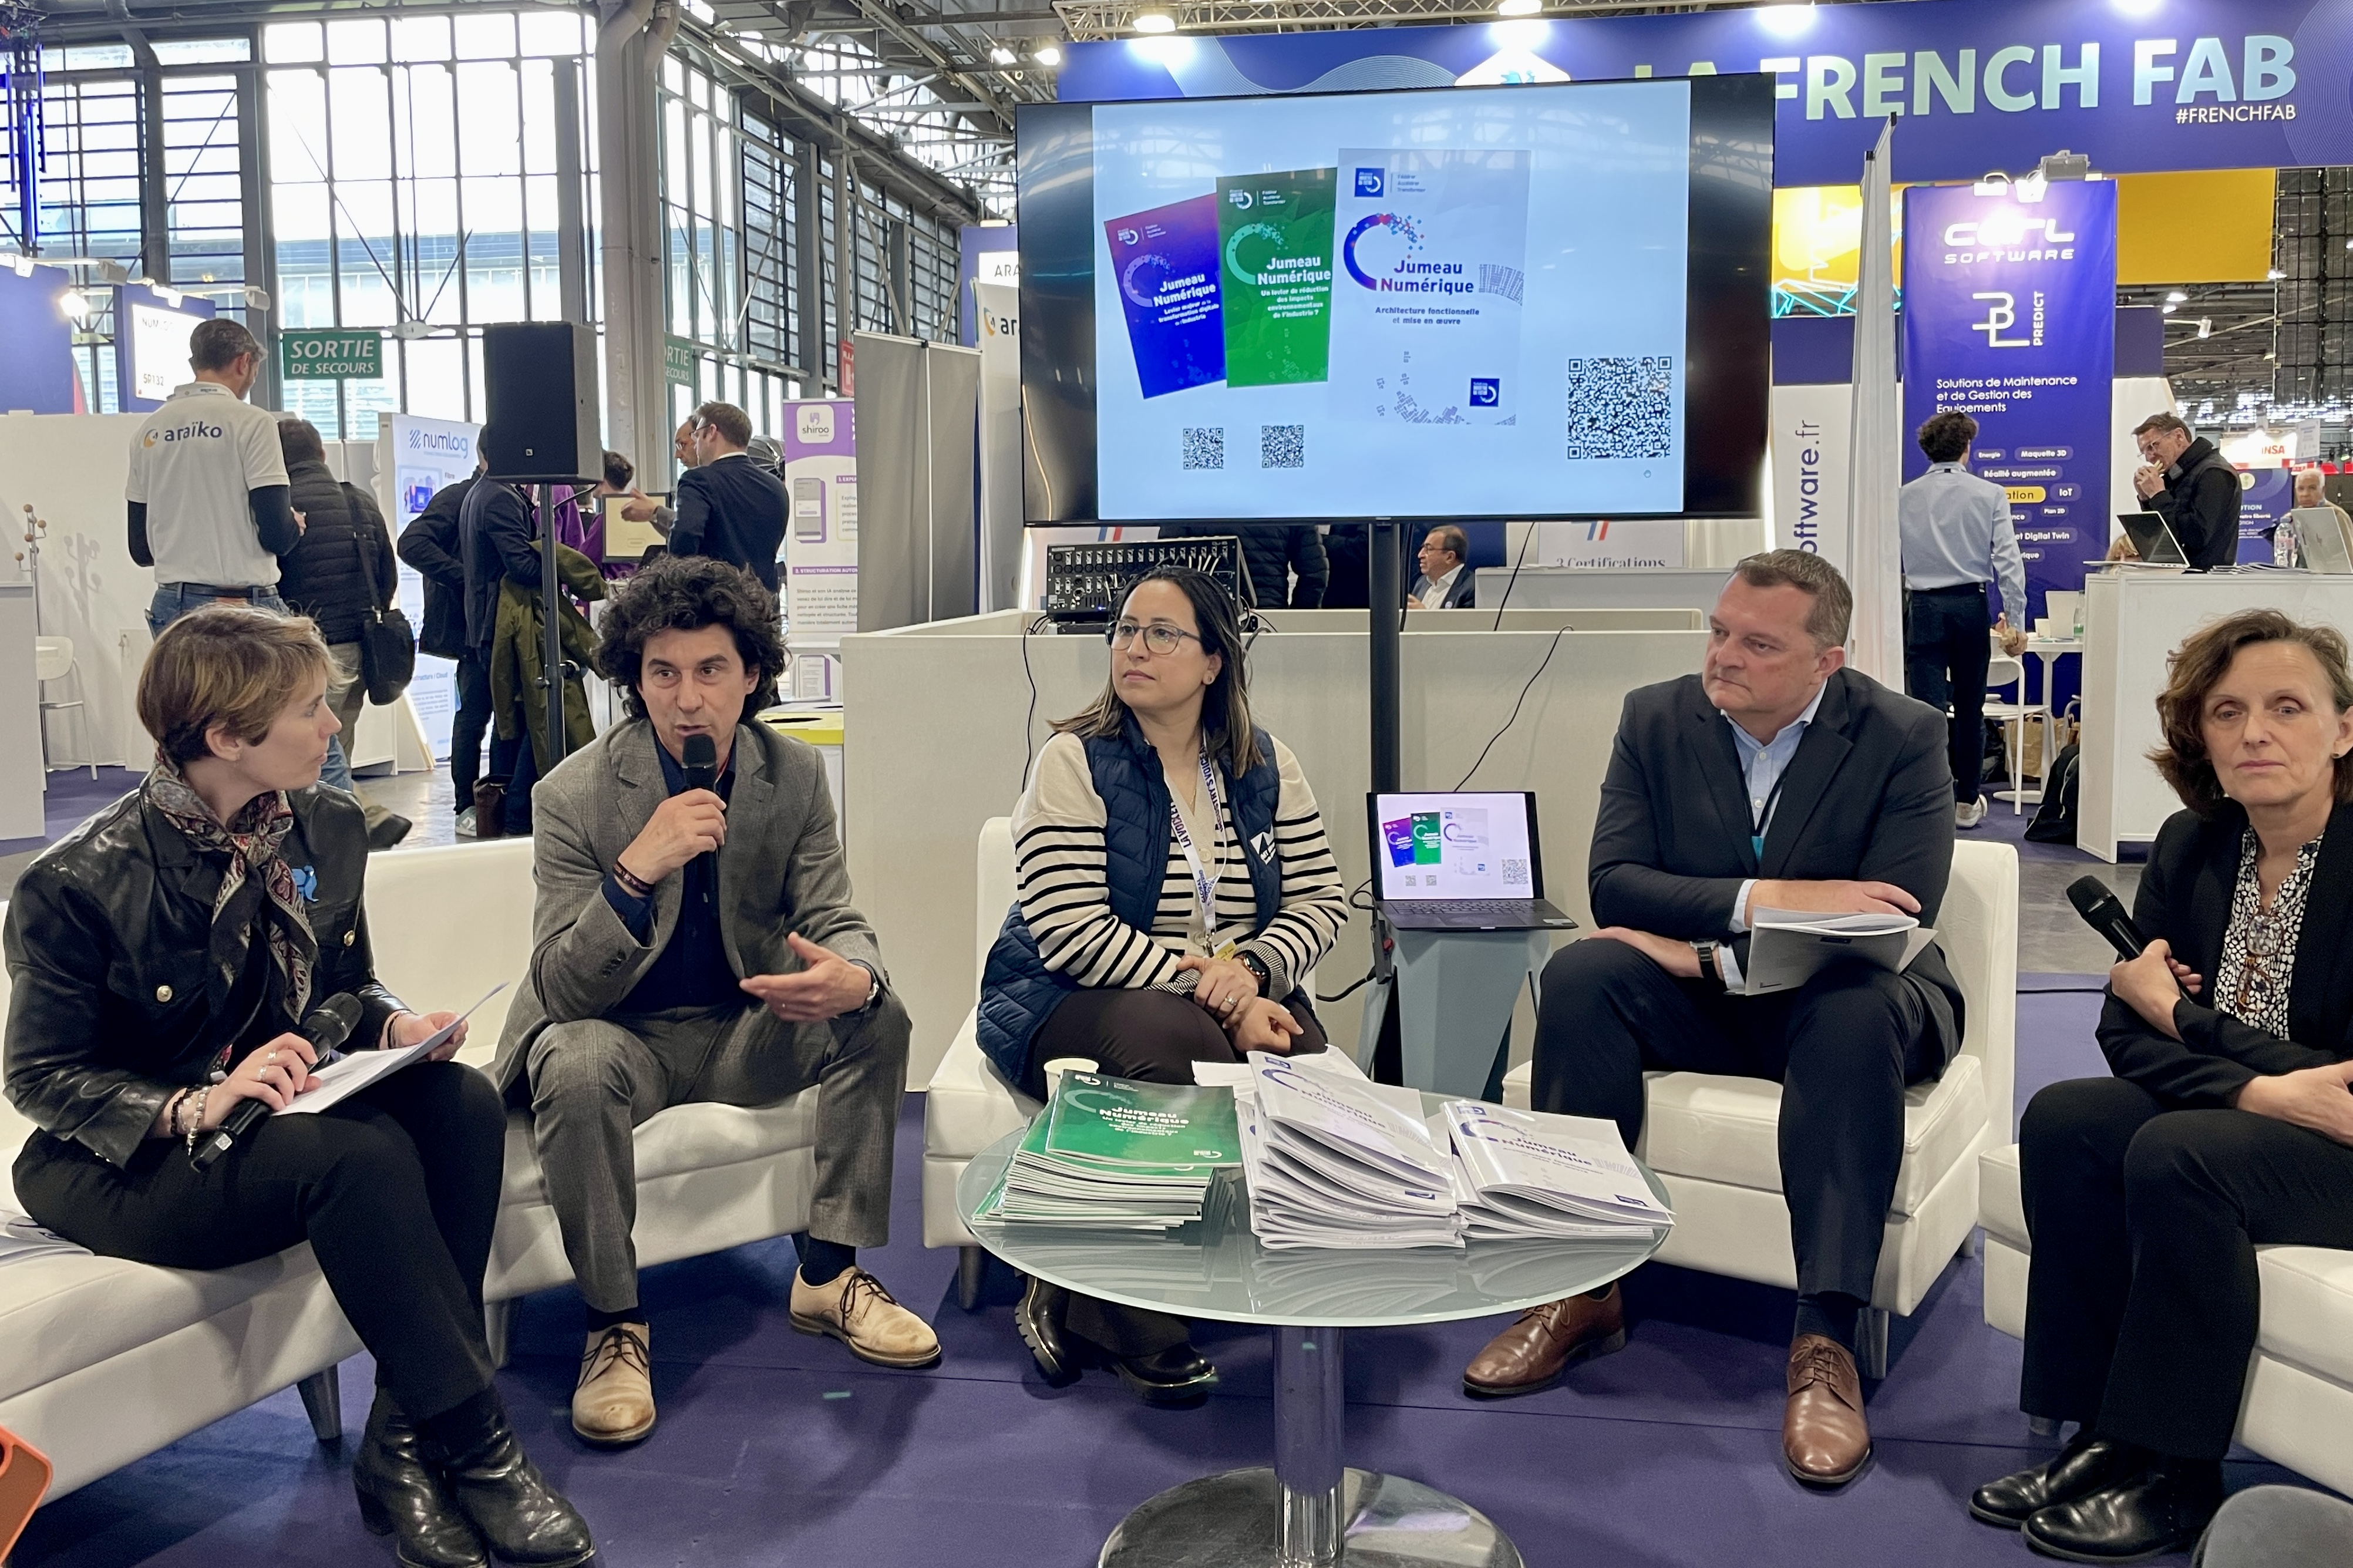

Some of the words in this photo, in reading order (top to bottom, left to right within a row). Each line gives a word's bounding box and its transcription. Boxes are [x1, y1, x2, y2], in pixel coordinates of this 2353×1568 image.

[1760, 42, 2099, 120] FRENCH
[2133, 35, 2297, 106] FAB
[2176, 105, 2297, 124] #FRENCHFAB
[1266, 257, 1321, 270] Jumeau
[1944, 249, 2075, 264] SOFTWARE
[995, 265, 1019, 277] ARA
[1393, 260, 1463, 274] Jumeau
[1160, 274, 1206, 292] Jumeau
[1257, 270, 1331, 285] Numérique
[1381, 278, 1474, 295] Numérique
[1153, 284, 1216, 307] Numérique
[1428, 307, 1480, 315] fonctionnelle
[2033, 291, 2044, 346] PREDICT
[1001, 318, 1019, 335] ar
[291, 339, 375, 359] SORTIE
[291, 363, 309, 375] DE
[315, 362, 375, 375] SECOURS
[666, 366, 689, 381] ECOURS
[1936, 378, 1983, 389] Solutions
[1985, 378, 2001, 388] de
[2003, 376, 2078, 387] Maintenance
[1936, 392, 1948, 401] et
[1950, 391, 1965, 401] de
[1968, 390, 2009, 401] Gestion
[2012, 389, 2032, 399] des
[164, 421, 223, 442] araïko
[802, 425, 829, 434] shiroo
[423, 432, 469, 459] numlog
[2011, 469, 2056, 479] augmentée
[1793, 420, 1819, 554] oftware.fr
[2059, 488, 2073, 496] IoT
[2007, 490, 2034, 500] ation
[2024, 533, 2050, 541] Digital
[1568, 557, 1665, 567] Certifications
[1099, 1109, 1190, 1125] Numérique
[1112, 1106, 1177, 1119] Jumeau
[1502, 1139, 1593, 1166] Numérique
[1511, 1137, 1577, 1157] Jumeau
